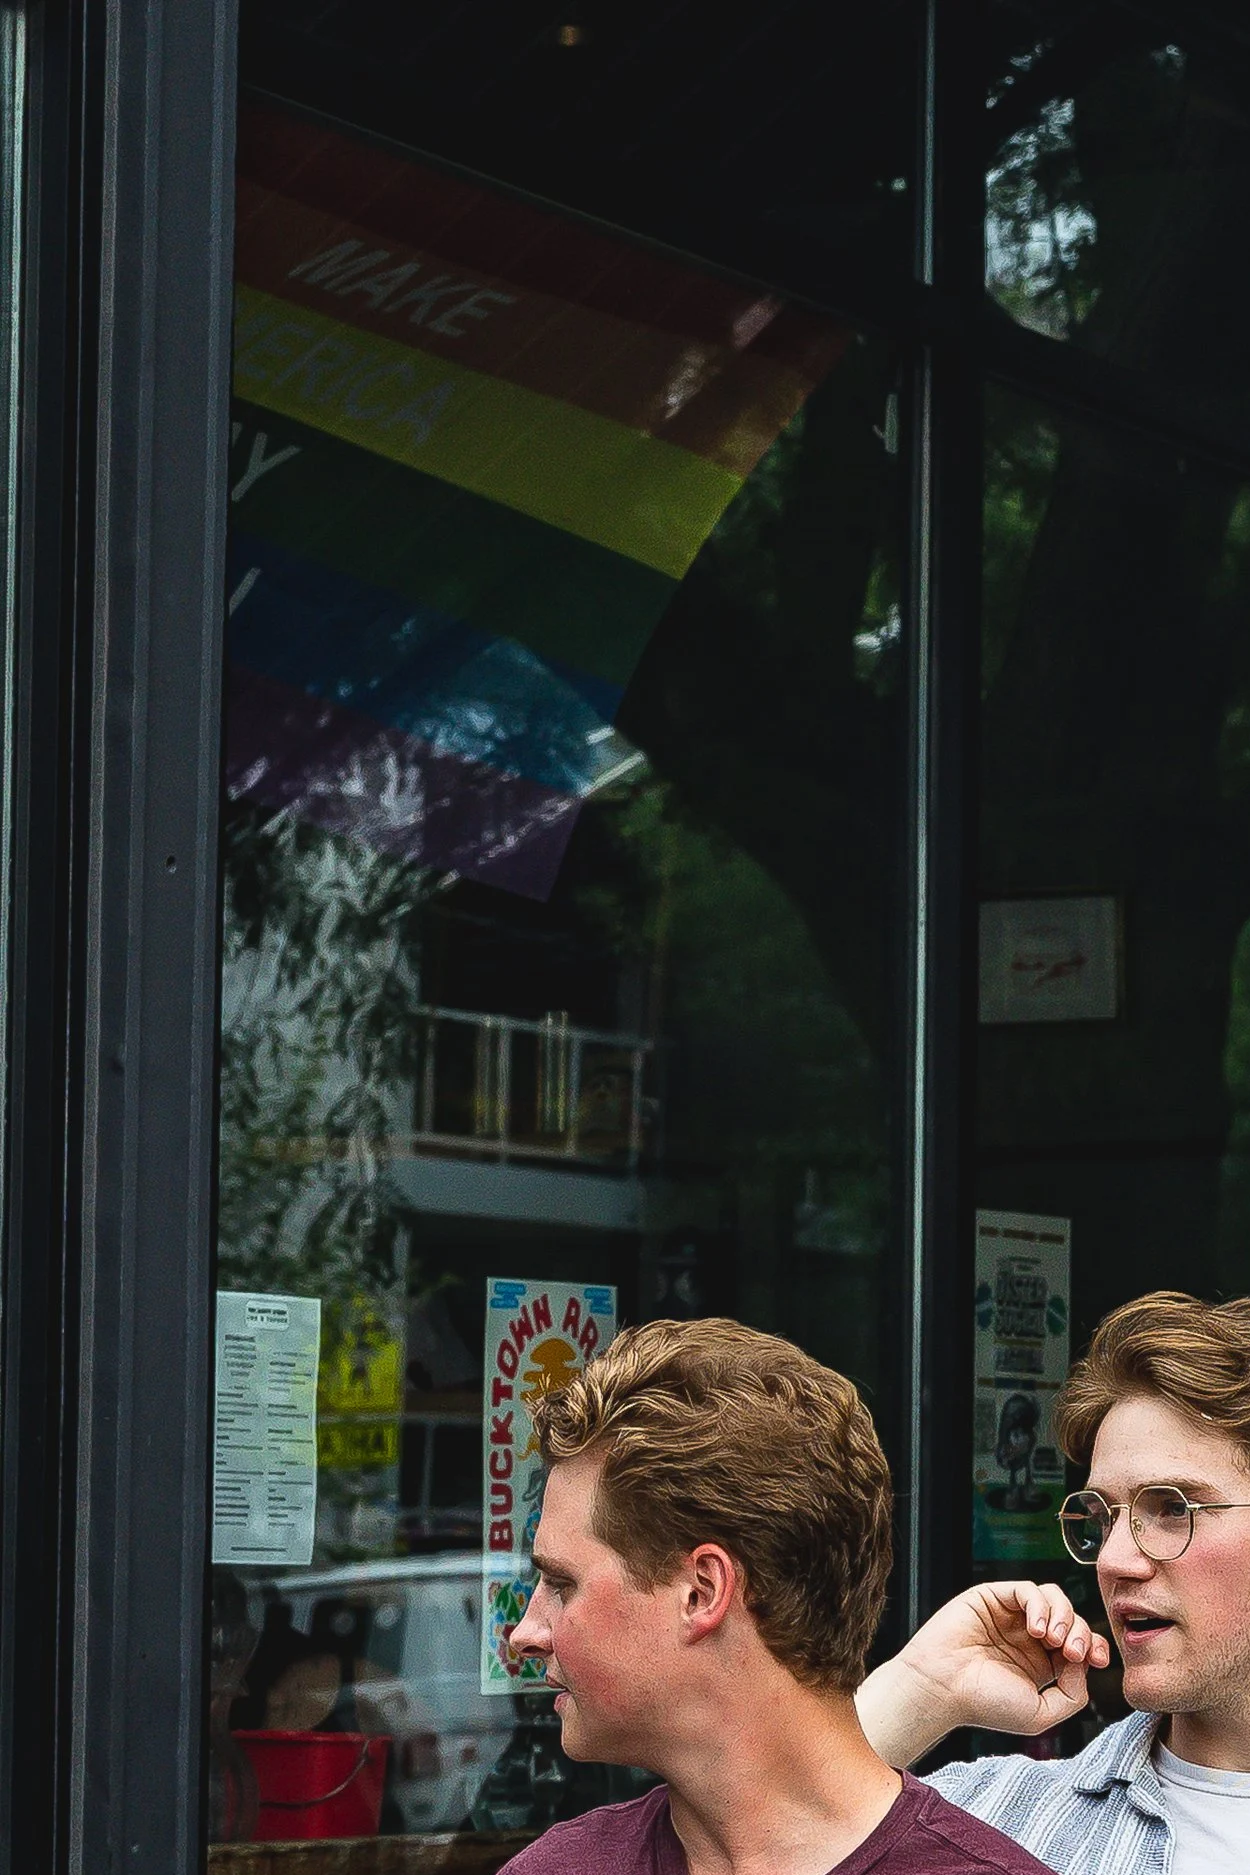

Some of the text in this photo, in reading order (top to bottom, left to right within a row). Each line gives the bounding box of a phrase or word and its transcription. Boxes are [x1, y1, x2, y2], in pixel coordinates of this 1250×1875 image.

[286, 237, 519, 338] MAKE
[231, 421, 304, 504] Y
[489, 1294, 553, 1552] BUCKTOWN
[562, 1296, 599, 1360] AR
